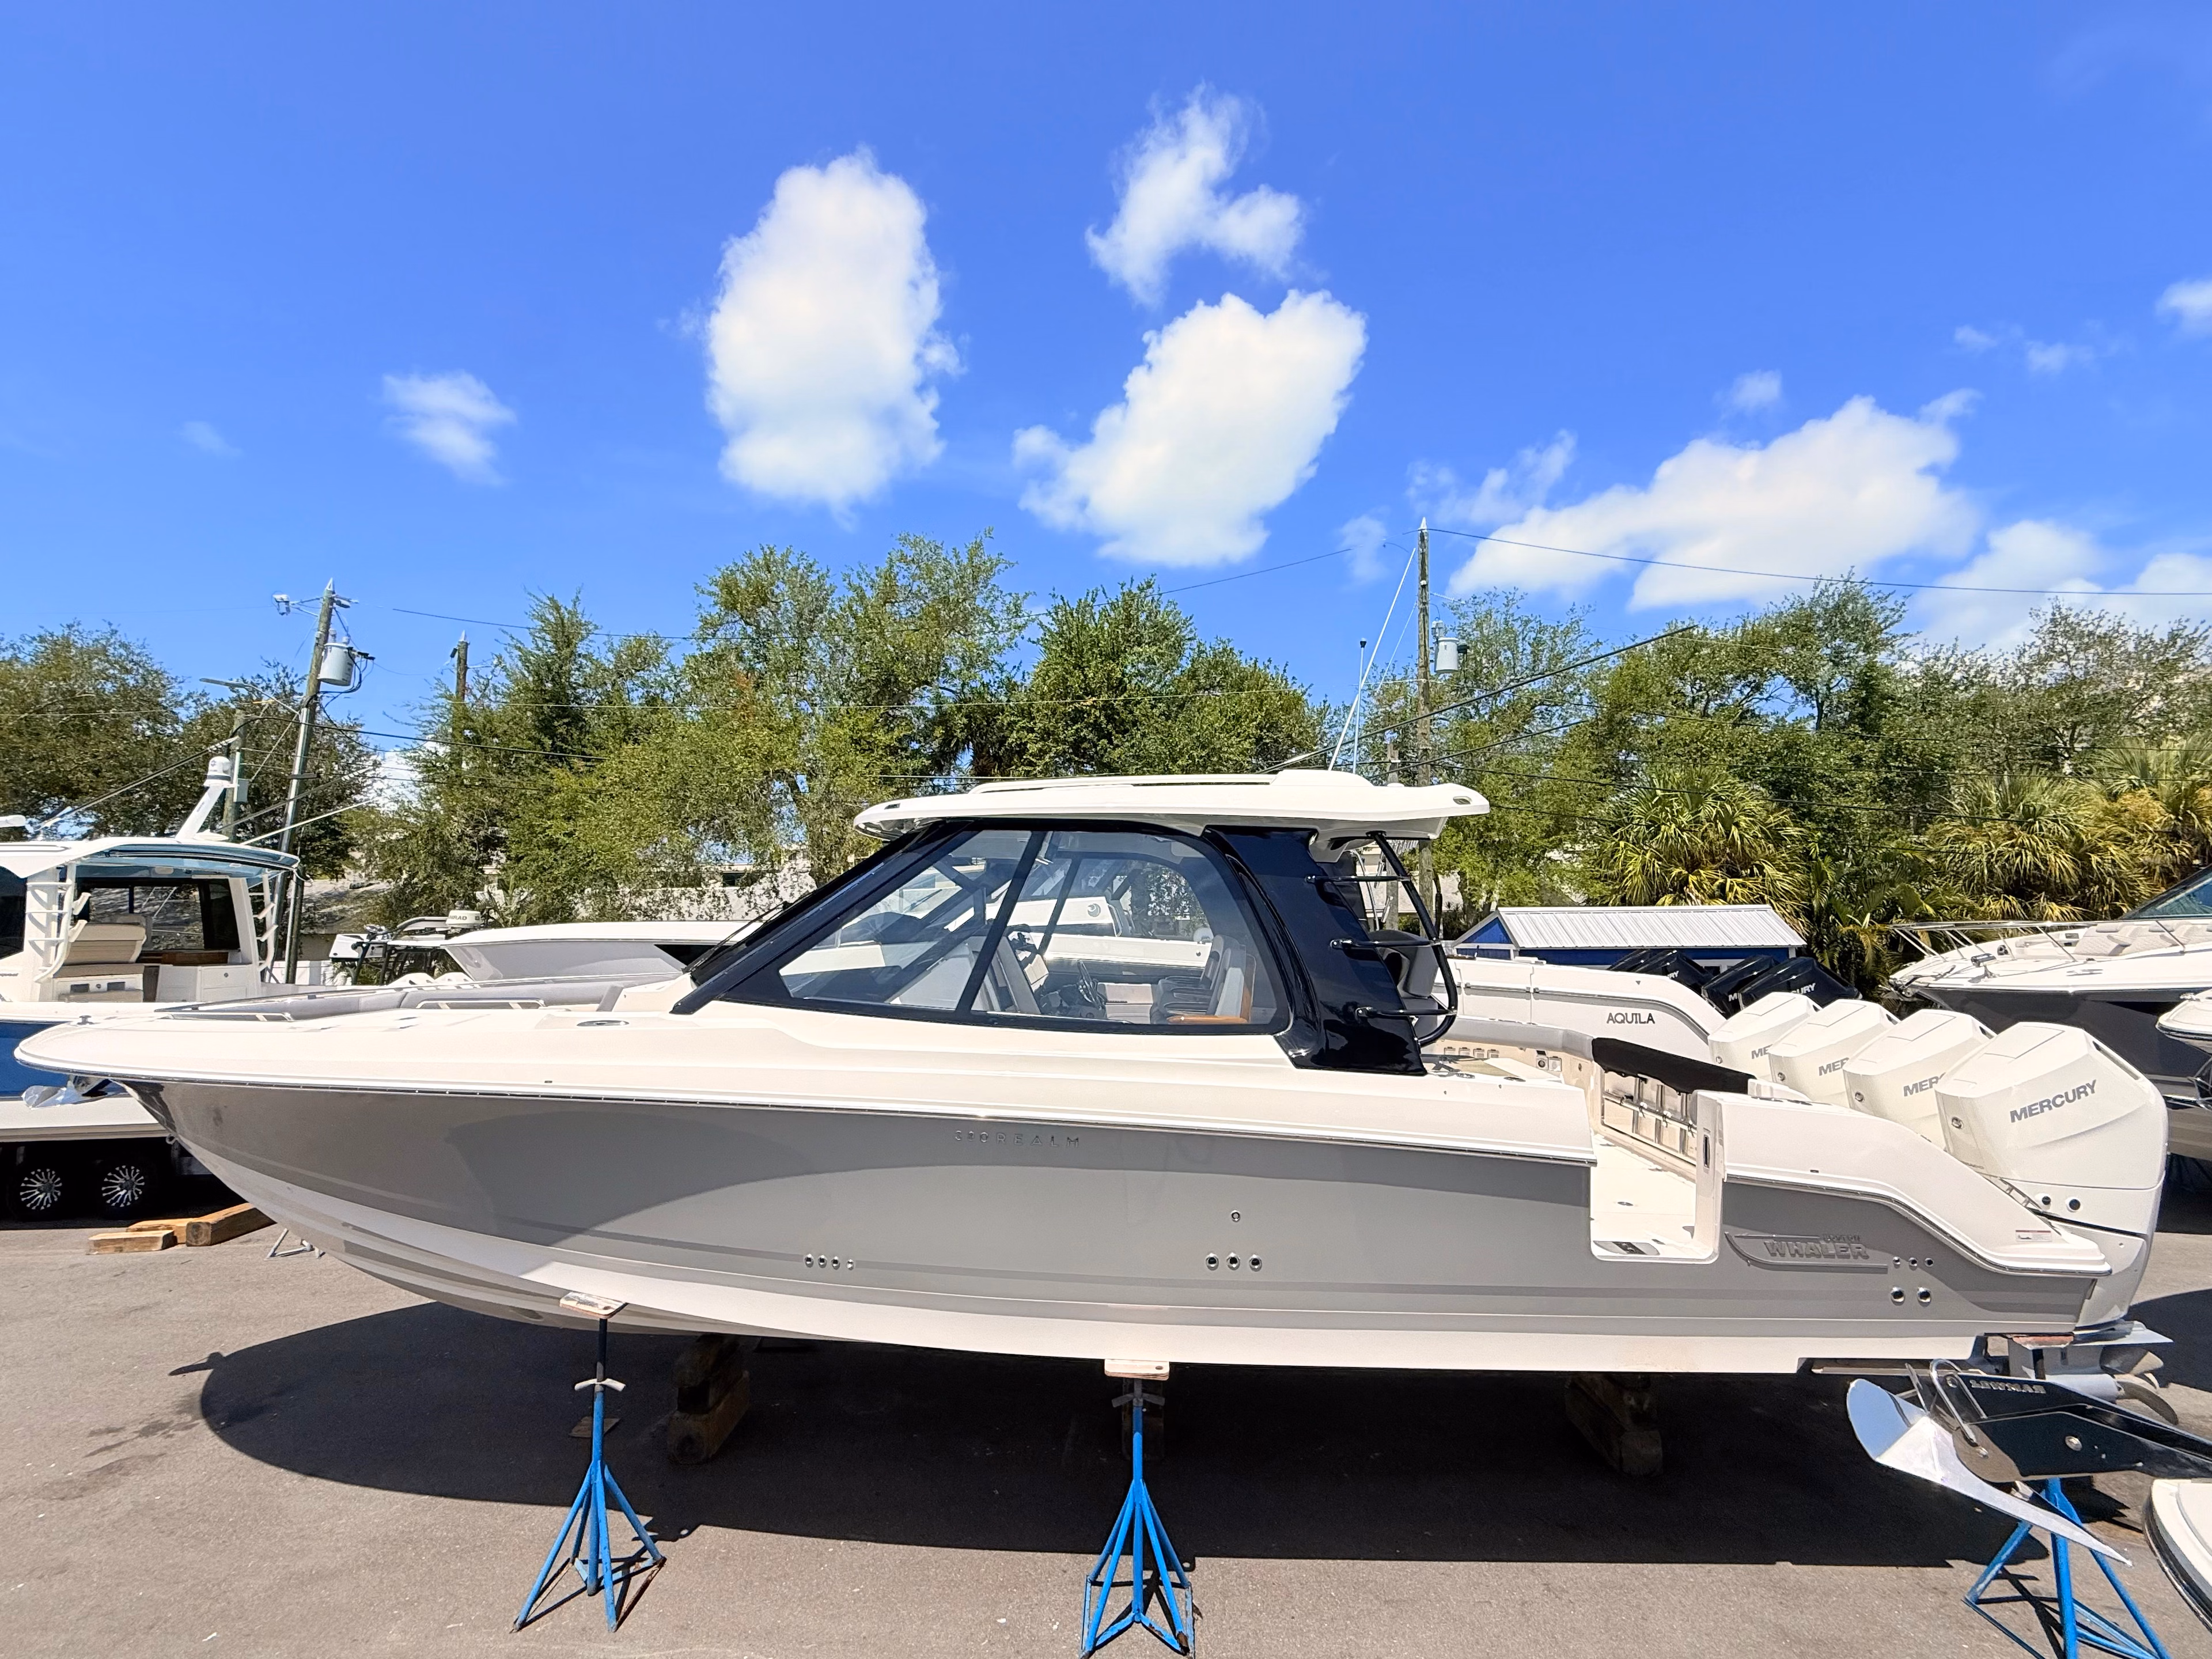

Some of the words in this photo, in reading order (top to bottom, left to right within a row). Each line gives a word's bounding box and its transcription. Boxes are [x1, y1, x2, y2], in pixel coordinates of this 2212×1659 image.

[1607, 1012, 1656, 1024] AQUILA
[2010, 1079, 2097, 1123] MERCURY
[997, 1133, 1080, 1147] REALM
[1763, 1240, 1870, 1260] WHALER
[1969, 1380, 2047, 1394] LEWMAR
